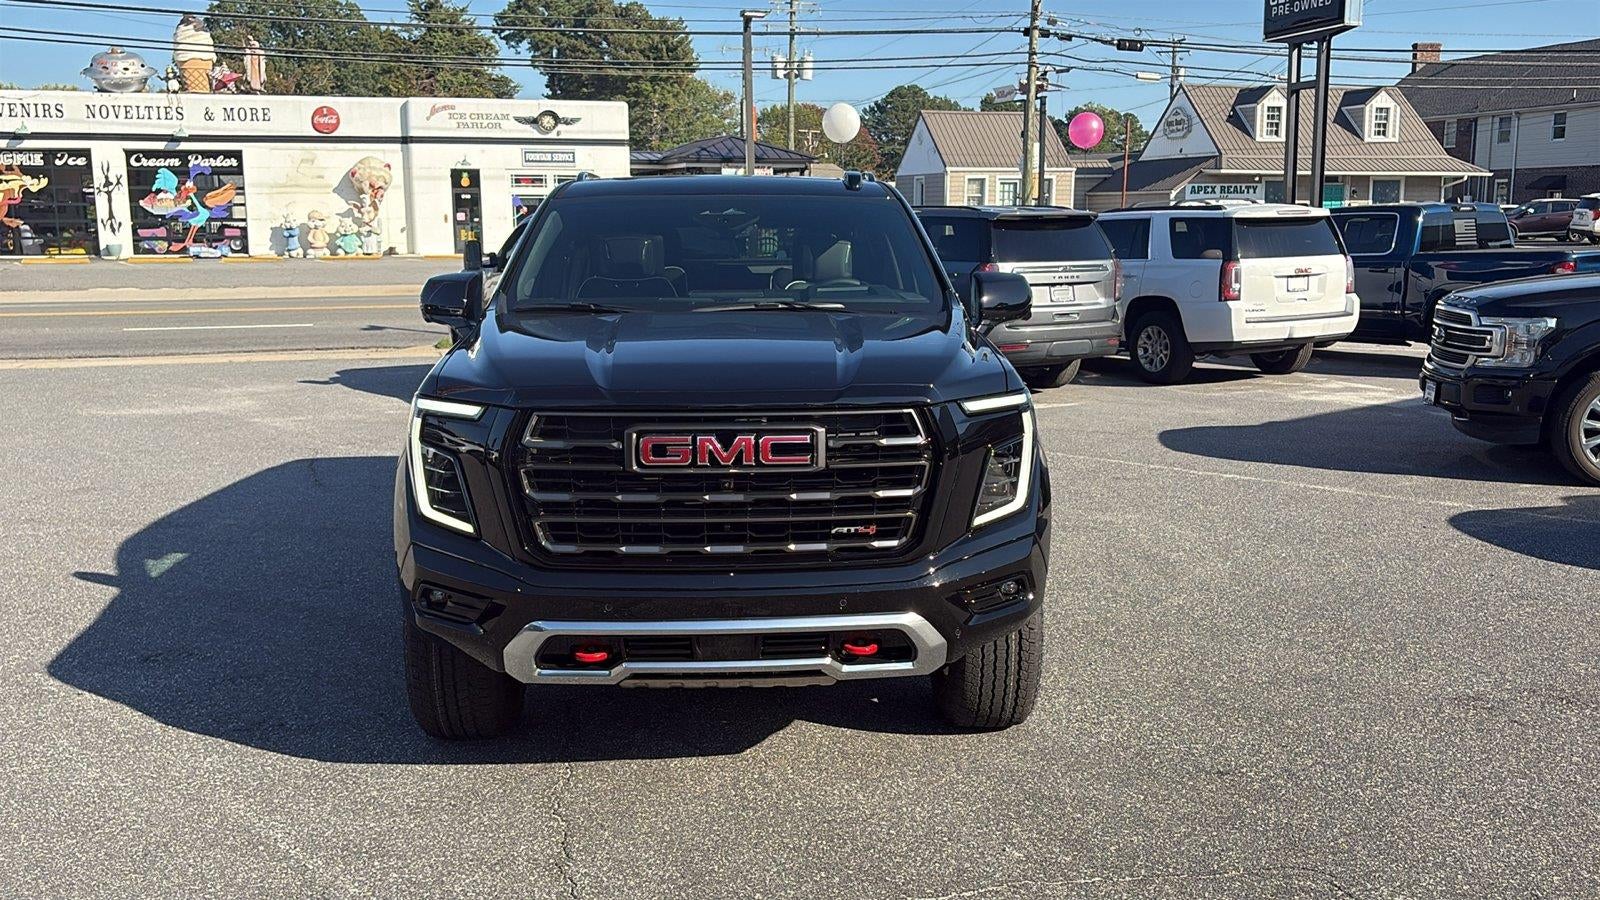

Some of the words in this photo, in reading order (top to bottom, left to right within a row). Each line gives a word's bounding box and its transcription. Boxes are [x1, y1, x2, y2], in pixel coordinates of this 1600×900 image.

[1271, 0, 1332, 17] PRE-OWNED
[85, 104, 185, 121] NOVELTIES
[203, 107, 215, 122] &
[223, 107, 272, 122] MORE
[448, 112, 467, 120] ICE
[469, 112, 511, 121] CREAM
[456, 121, 503, 130] PARLOR
[54, 152, 89, 166] Ice
[129, 153, 182, 167] Cream
[187, 154, 239, 168] Parlor
[552, 153, 573, 161] SERVICE
[1190, 185, 1217, 194] APEX
[1219, 185, 1258, 194] REALTY
[639, 434, 812, 466] GMC
[831, 525, 877, 535] AT4
